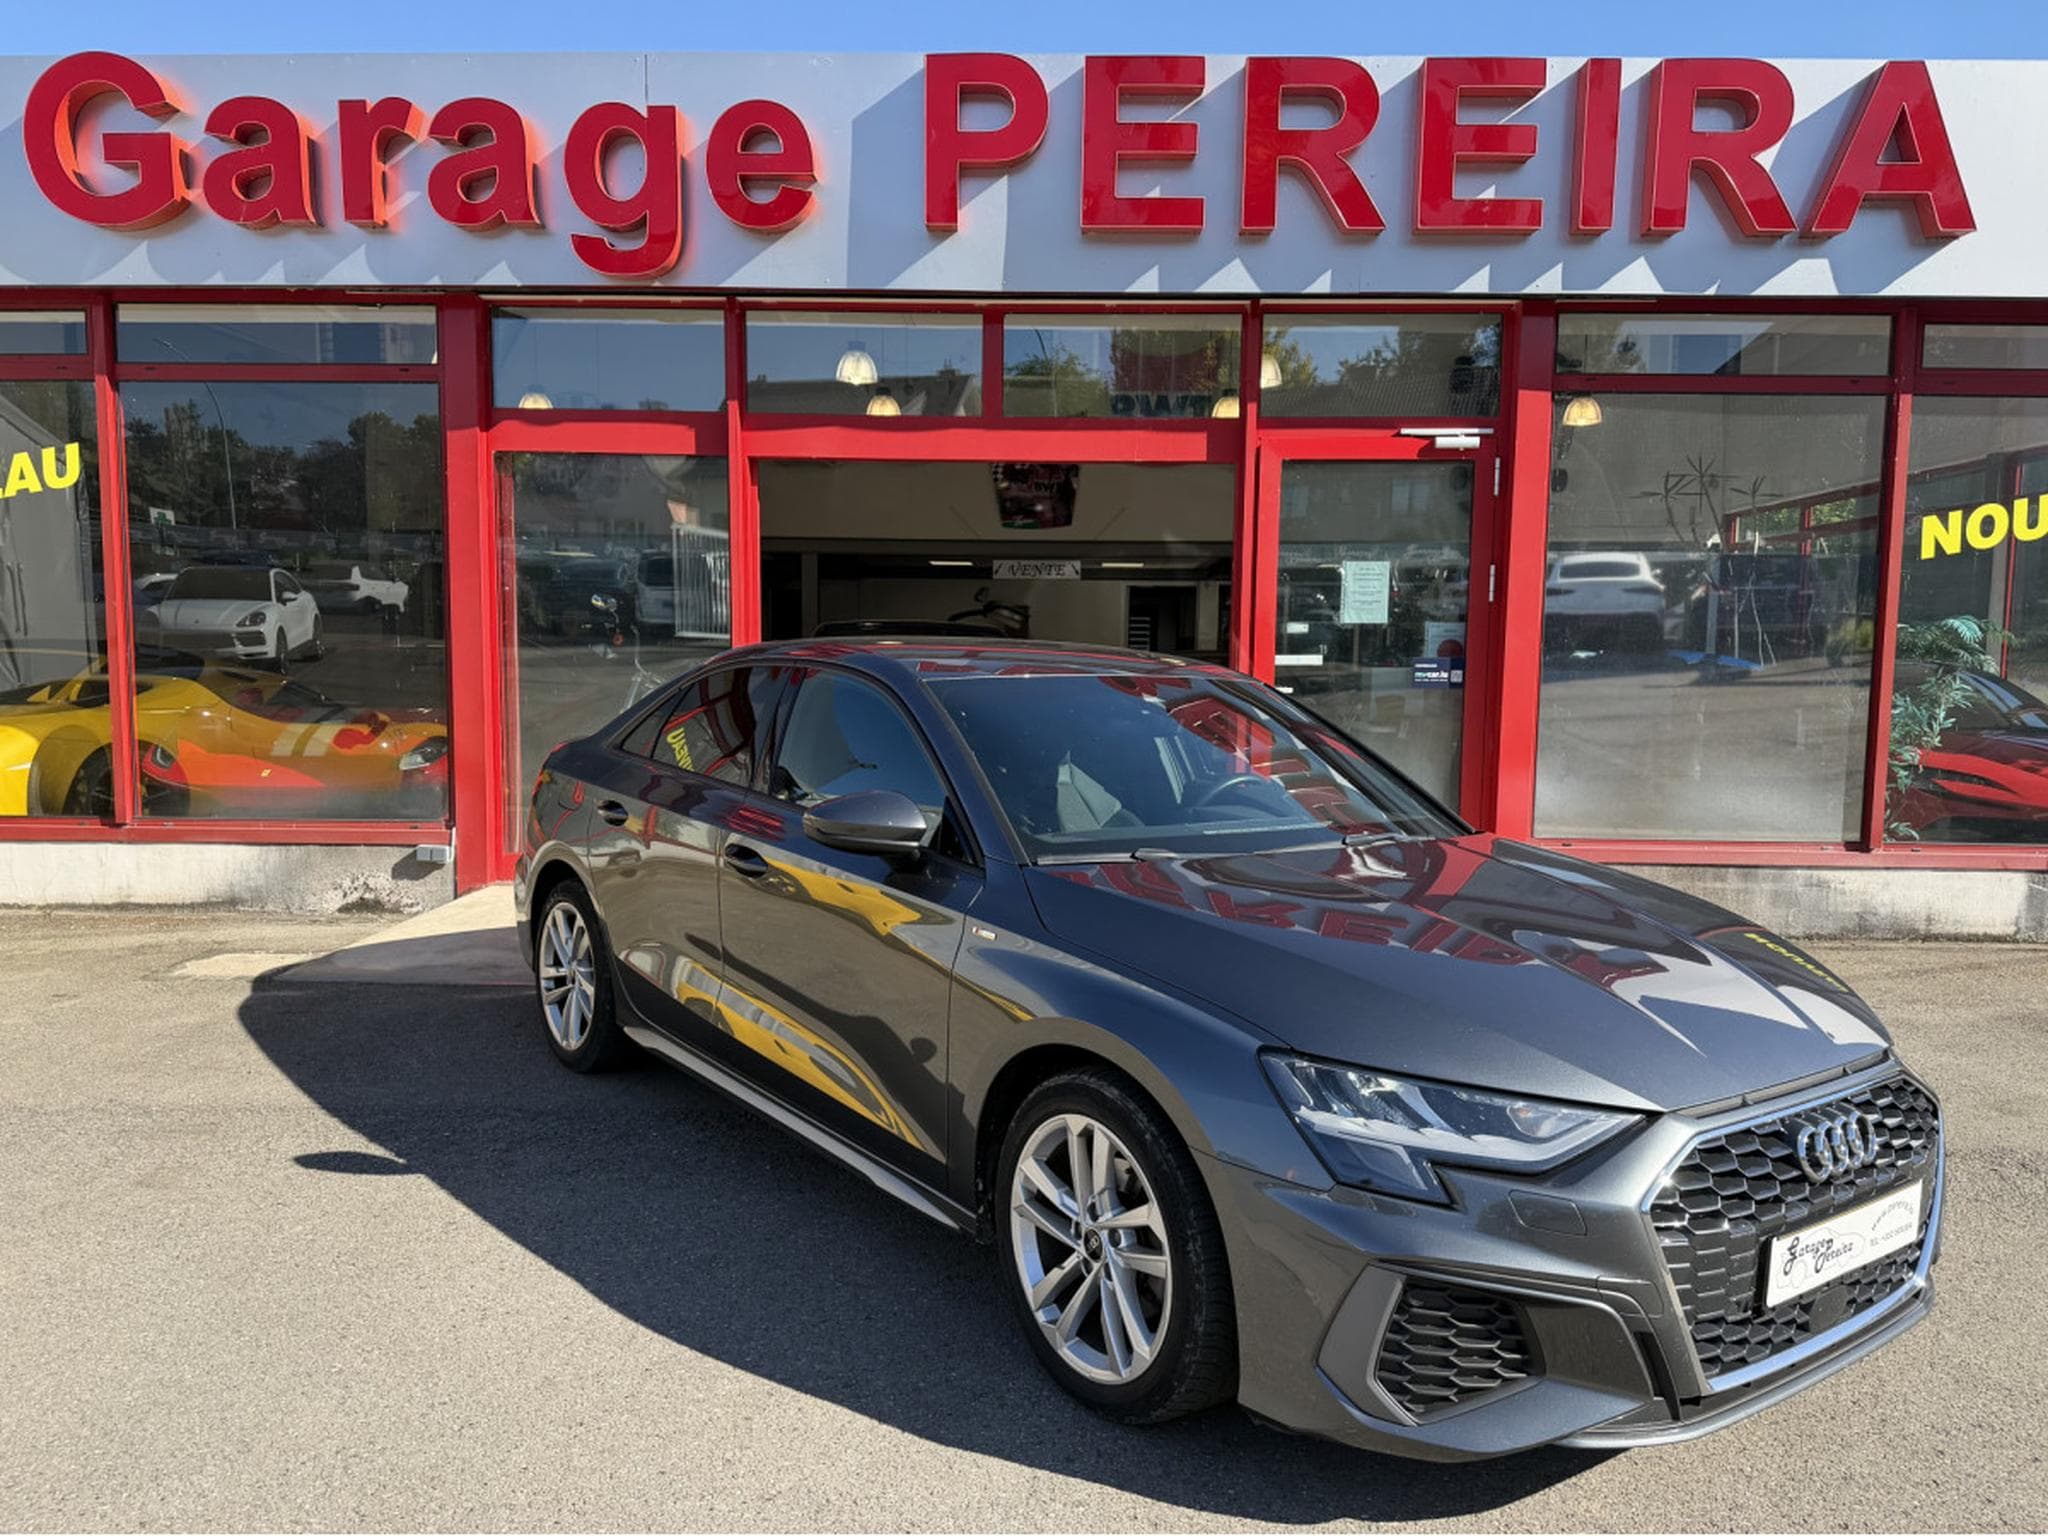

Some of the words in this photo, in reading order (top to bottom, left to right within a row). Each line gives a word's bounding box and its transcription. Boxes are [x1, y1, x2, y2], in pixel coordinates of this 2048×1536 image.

[23, 50, 819, 278] Garage
[923, 52, 1978, 239] PEREIRA
[0, 442, 80, 499] AU
[1921, 493, 2048, 560] NOU
[1008, 562, 1066, 577] VENTE
